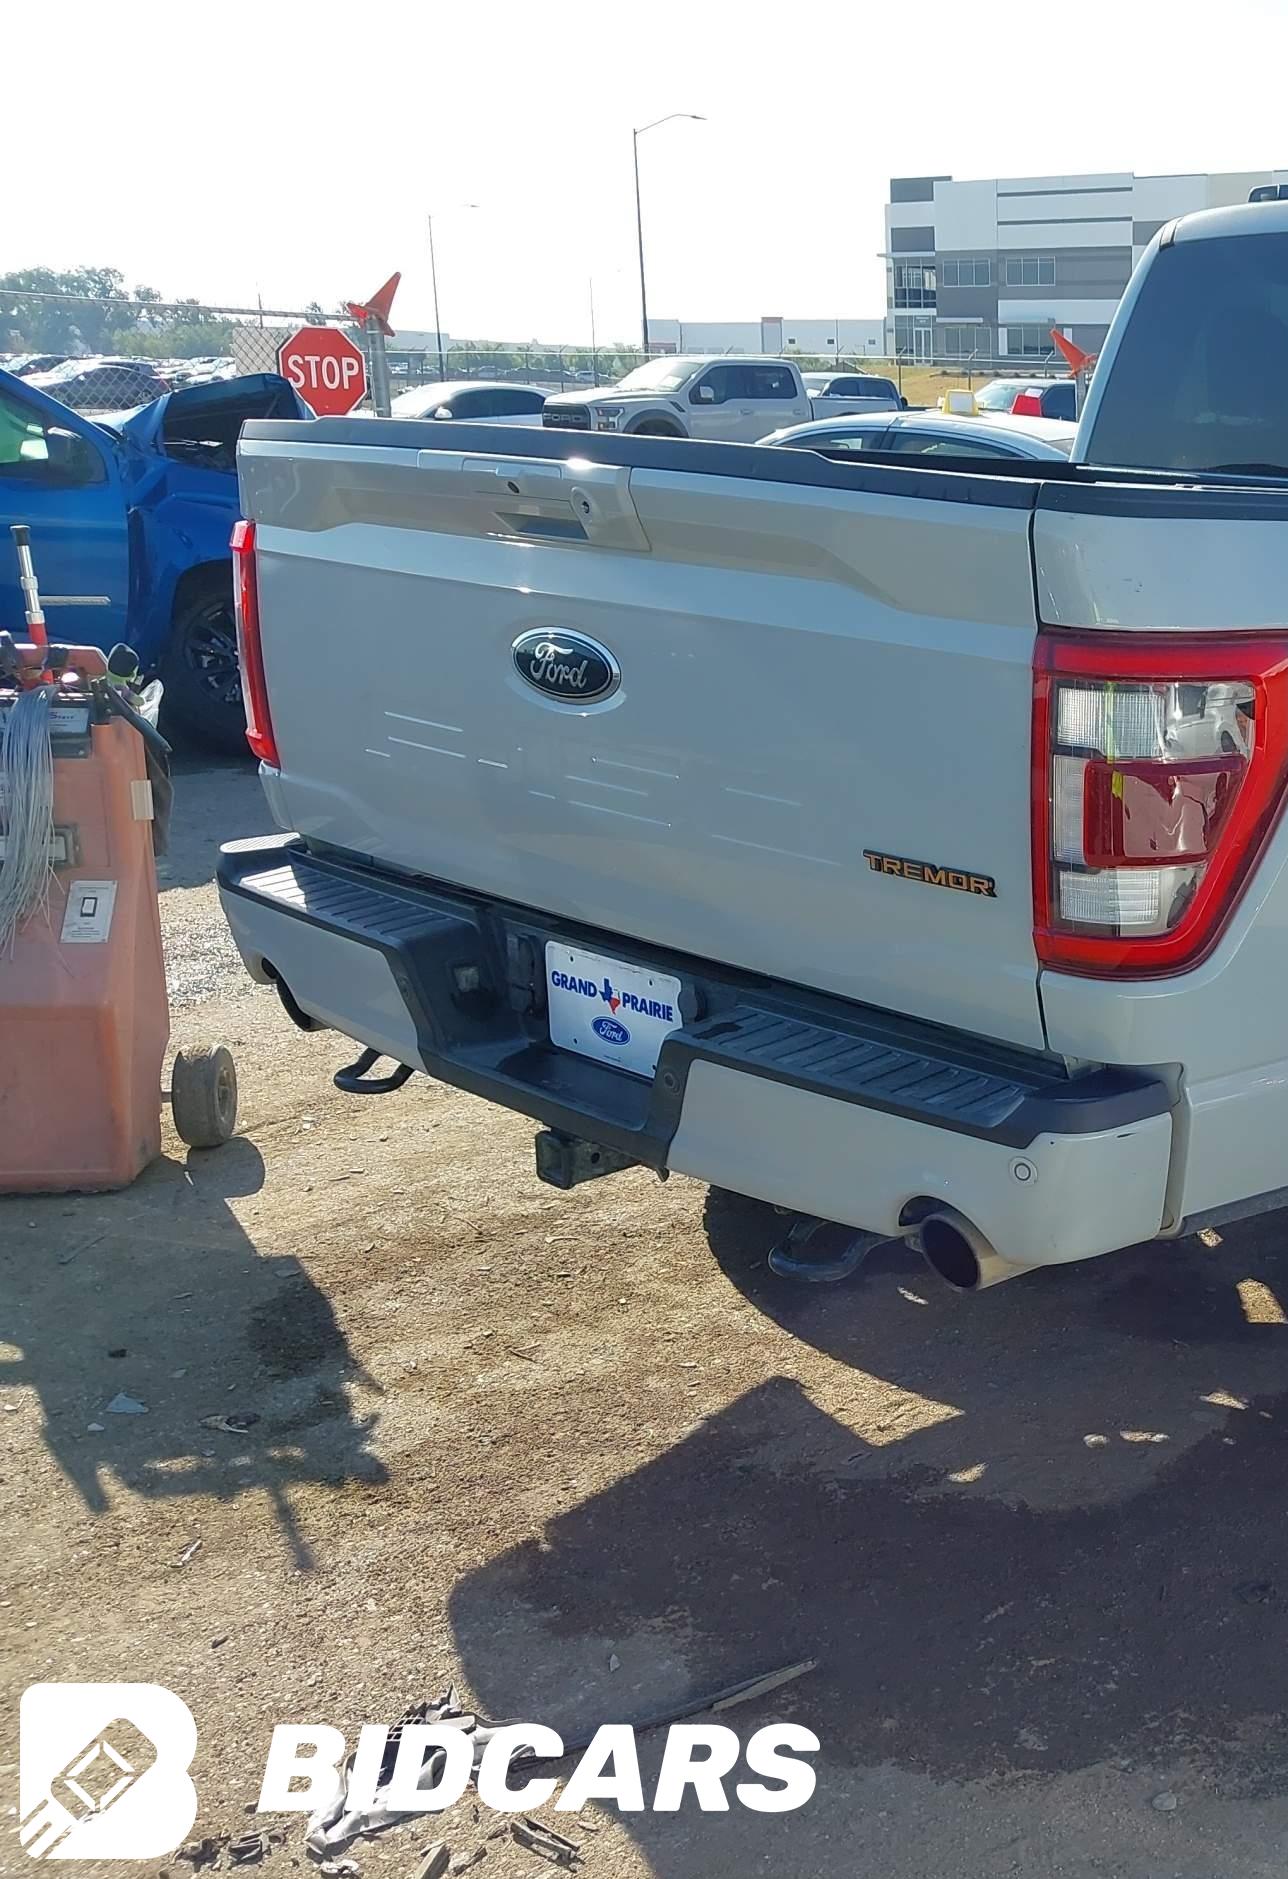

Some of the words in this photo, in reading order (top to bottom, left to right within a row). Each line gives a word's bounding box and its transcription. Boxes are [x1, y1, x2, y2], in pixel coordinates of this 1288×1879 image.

[287, 354, 360, 390] STOP
[529, 641, 589, 689] Ford
[863, 849, 997, 898] TREMOR
[551, 970, 598, 998] GRAND
[621, 991, 674, 1023] PRAIRIE
[599, 1019, 624, 1042] Ford
